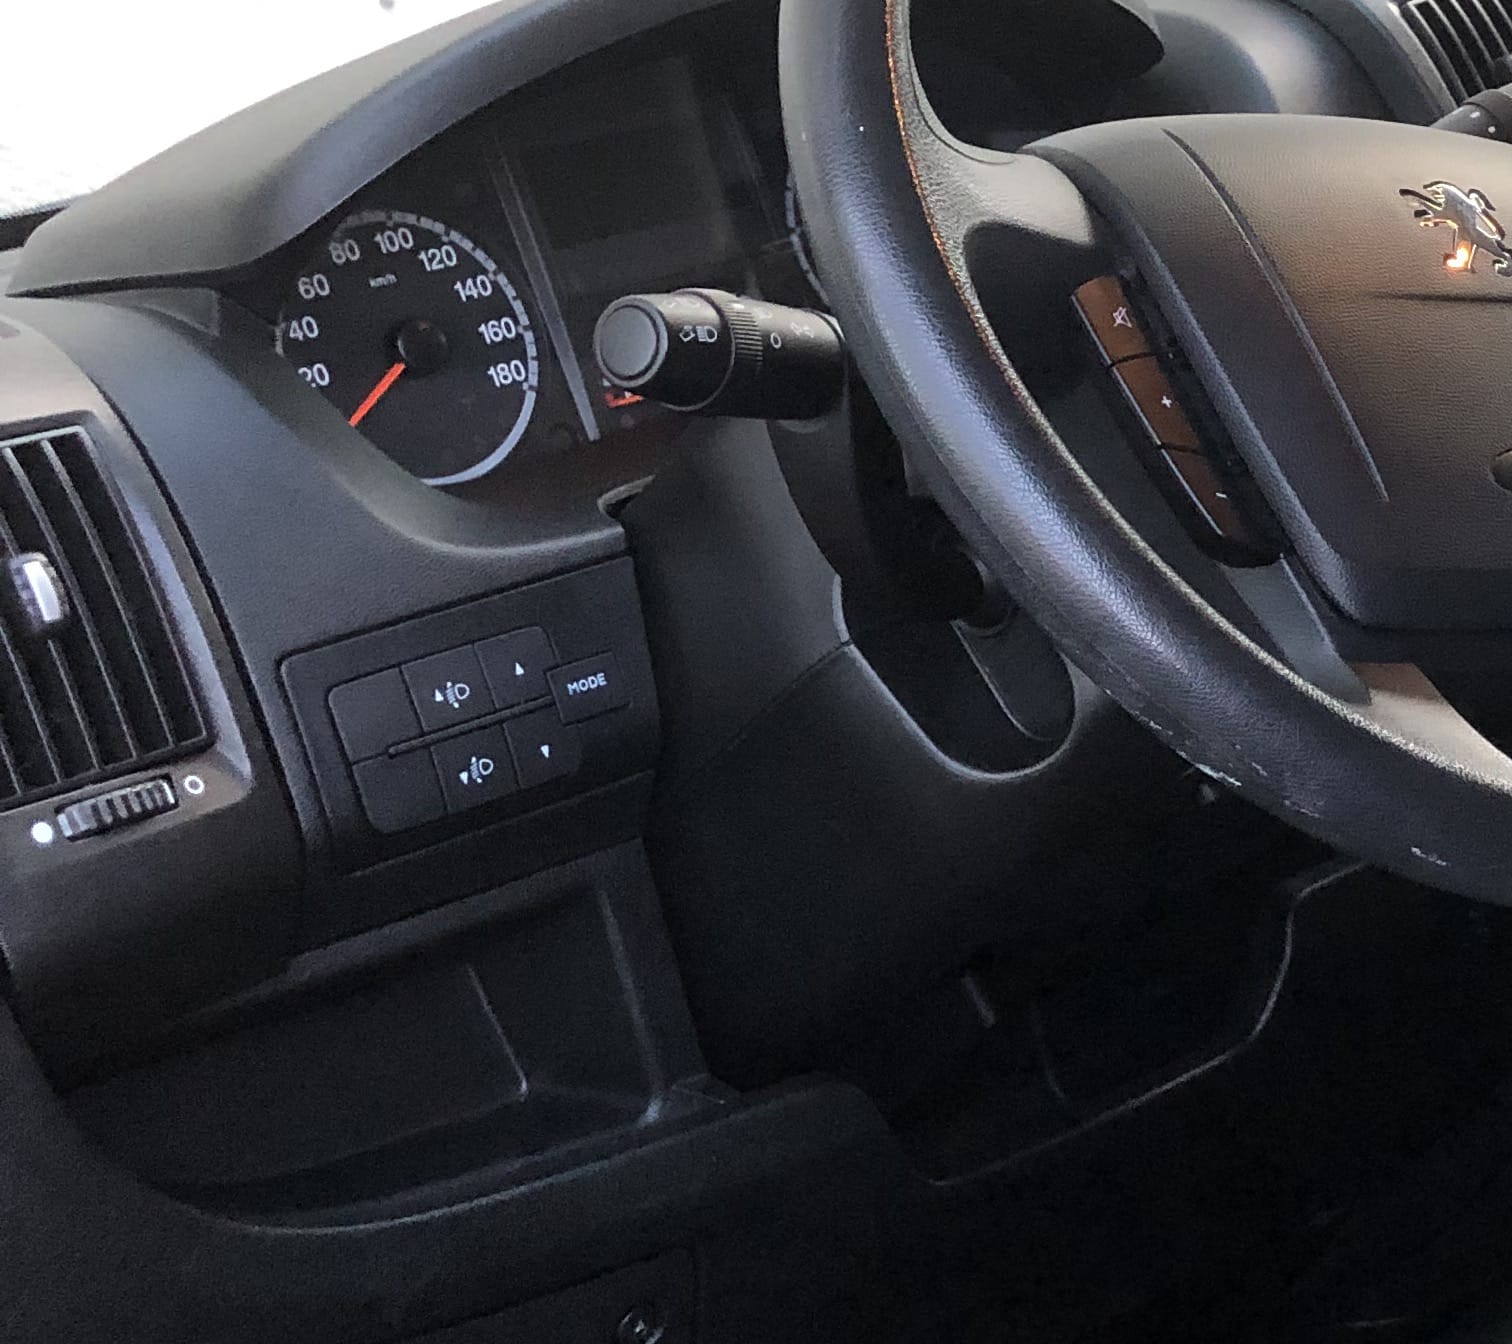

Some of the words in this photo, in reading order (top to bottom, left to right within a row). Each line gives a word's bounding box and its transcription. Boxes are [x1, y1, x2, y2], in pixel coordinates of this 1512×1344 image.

[328, 238, 361, 265] 80
[374, 227, 414, 254] 100
[417, 244, 457, 272] 120
[298, 273, 331, 299] 60
[453, 274, 493, 302] 140
[289, 315, 319, 341] 40
[478, 316, 516, 344] 160
[487, 359, 526, 388] 180
[567, 672, 608, 695] MODE
